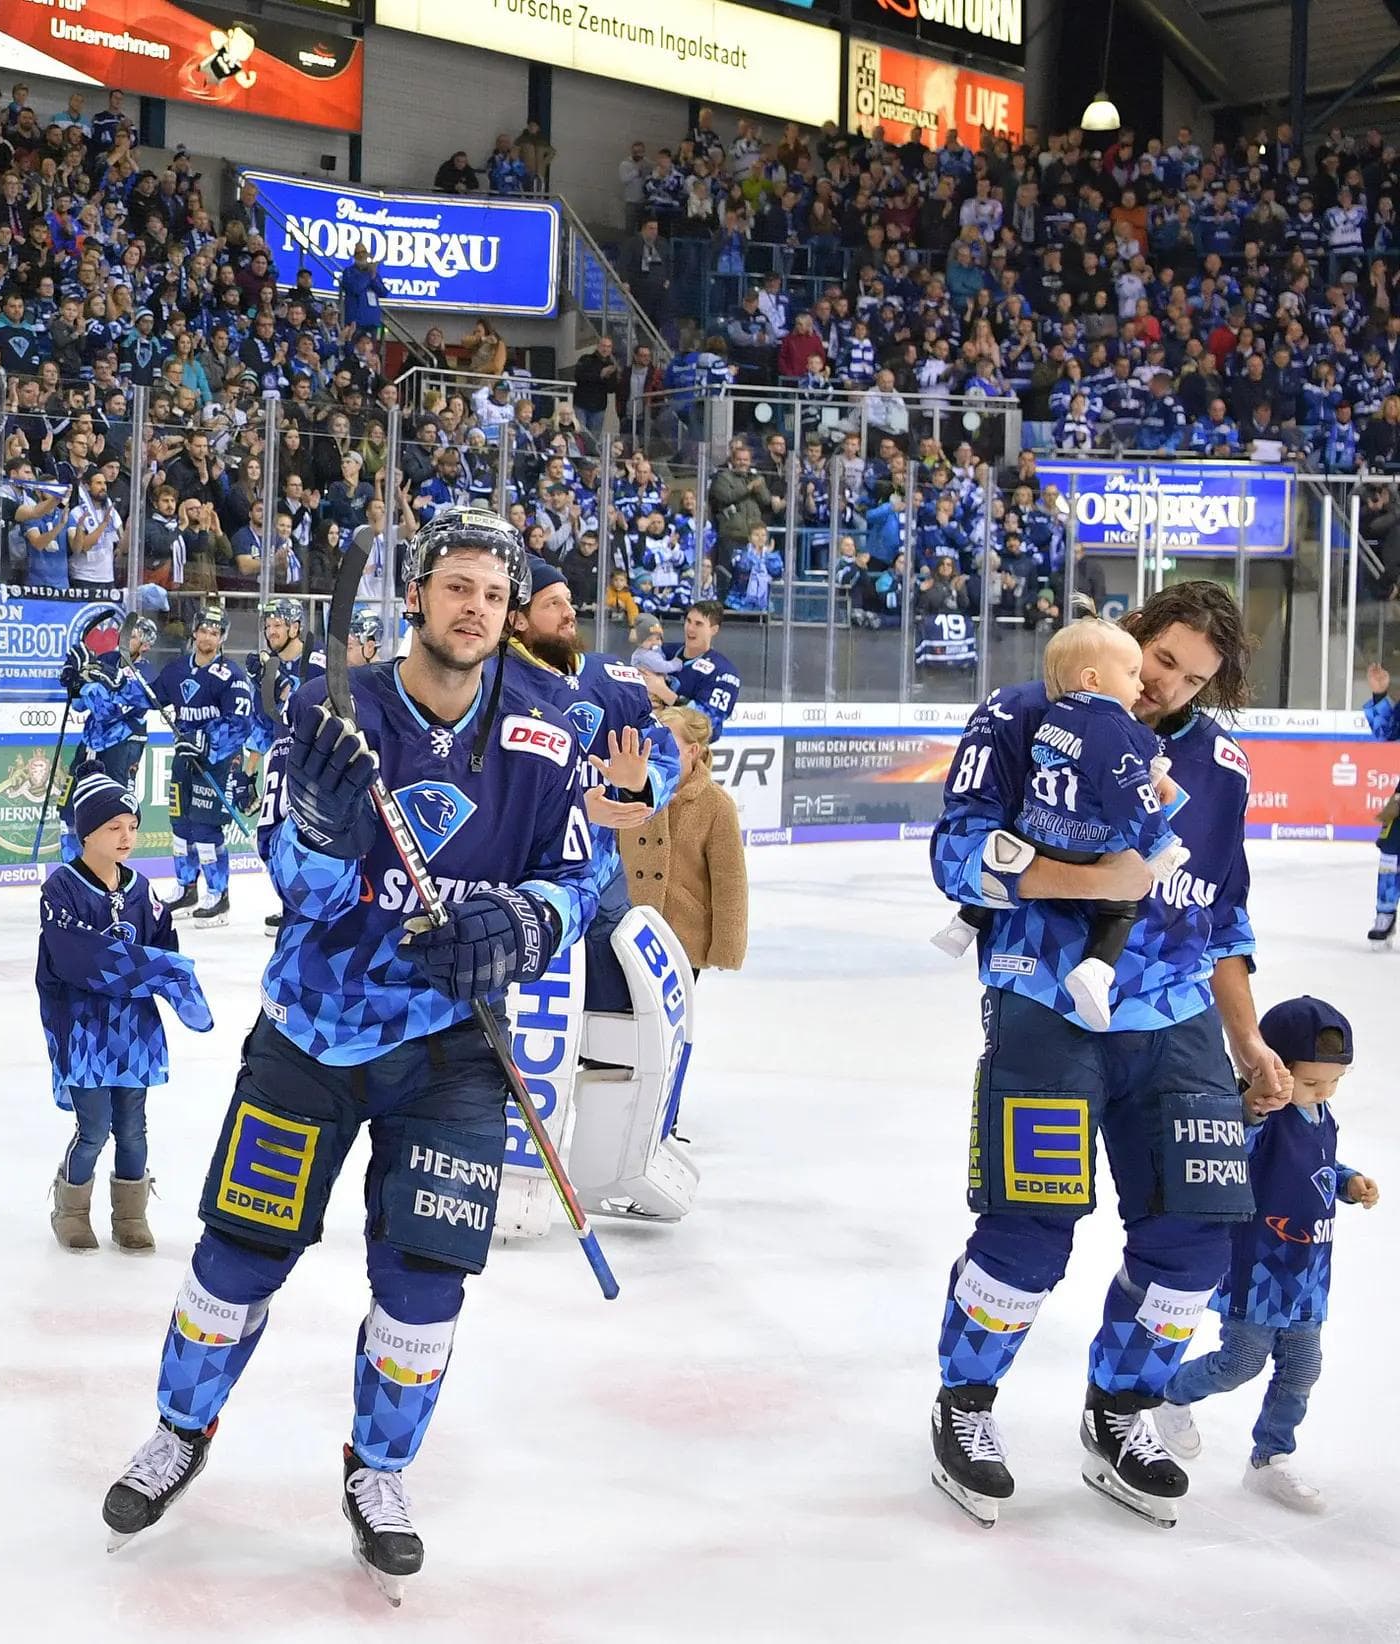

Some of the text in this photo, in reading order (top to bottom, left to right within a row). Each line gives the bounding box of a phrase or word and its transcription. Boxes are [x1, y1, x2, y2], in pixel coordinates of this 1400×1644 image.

[50, 18, 171, 60] Unternehmen
[493, 0, 747, 69] orsche Zentrum Ingolstadt
[879, 82, 906, 104] DAS
[879, 101, 940, 130] ORIGINAL
[965, 84, 1010, 133] LIVE
[282, 214, 500, 278] NORDBRÄU
[23, 585, 90, 599] PREDATORS
[935, 613, 966, 640] 19
[708, 687, 732, 712] 53
[742, 710, 767, 721] Audi
[836, 710, 862, 721] Audi
[1286, 716, 1320, 728] Audi
[508, 727, 567, 754] DEL
[795, 740, 924, 753] BRING DEN PUCK INS NETZ
[795, 756, 892, 769] BEWIRB DICH JETZT!
[952, 744, 992, 794] 81
[1248, 791, 1288, 809] stätt
[750, 831, 788, 844] covestro
[1014, 1179, 1085, 1196] EDEKA
[224, 1189, 294, 1221] EDEKA
[412, 1188, 489, 1232] BRÄU
